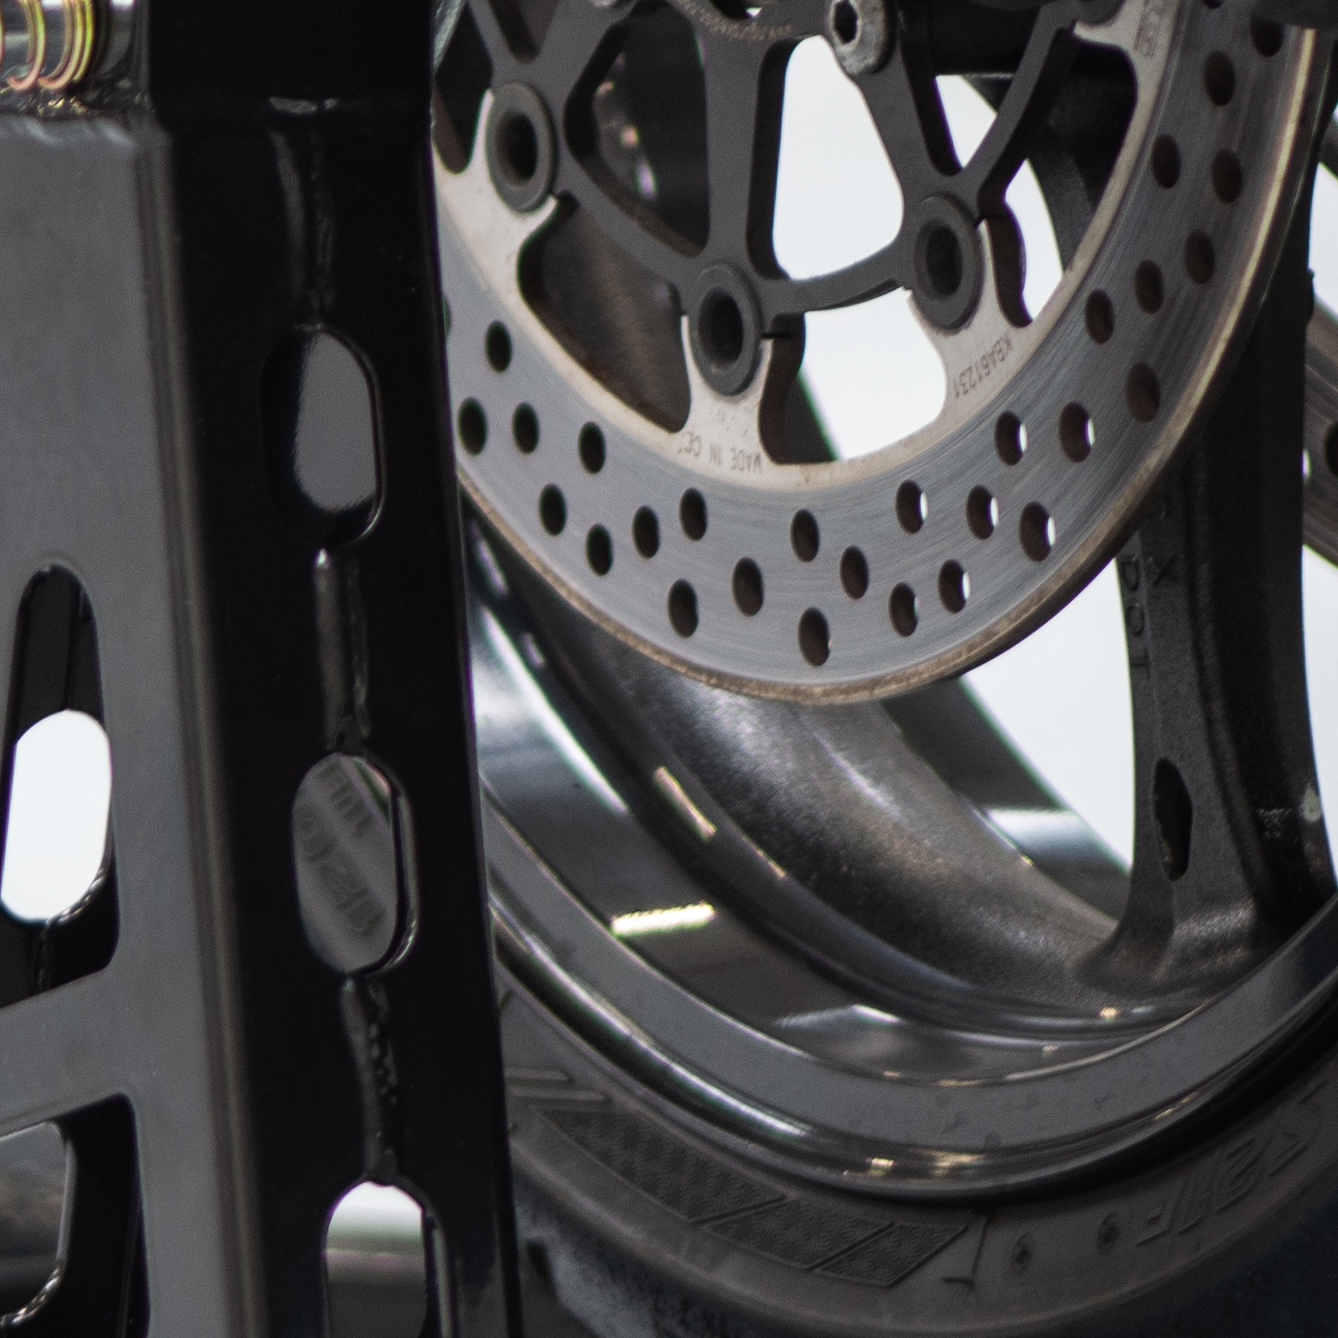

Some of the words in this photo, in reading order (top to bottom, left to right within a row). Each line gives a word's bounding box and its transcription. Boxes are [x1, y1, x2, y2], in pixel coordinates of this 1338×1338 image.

[954, 335, 1013, 399] KBA61231
[708, 443, 722, 468] IN
[729, 447, 762, 474] MADE
